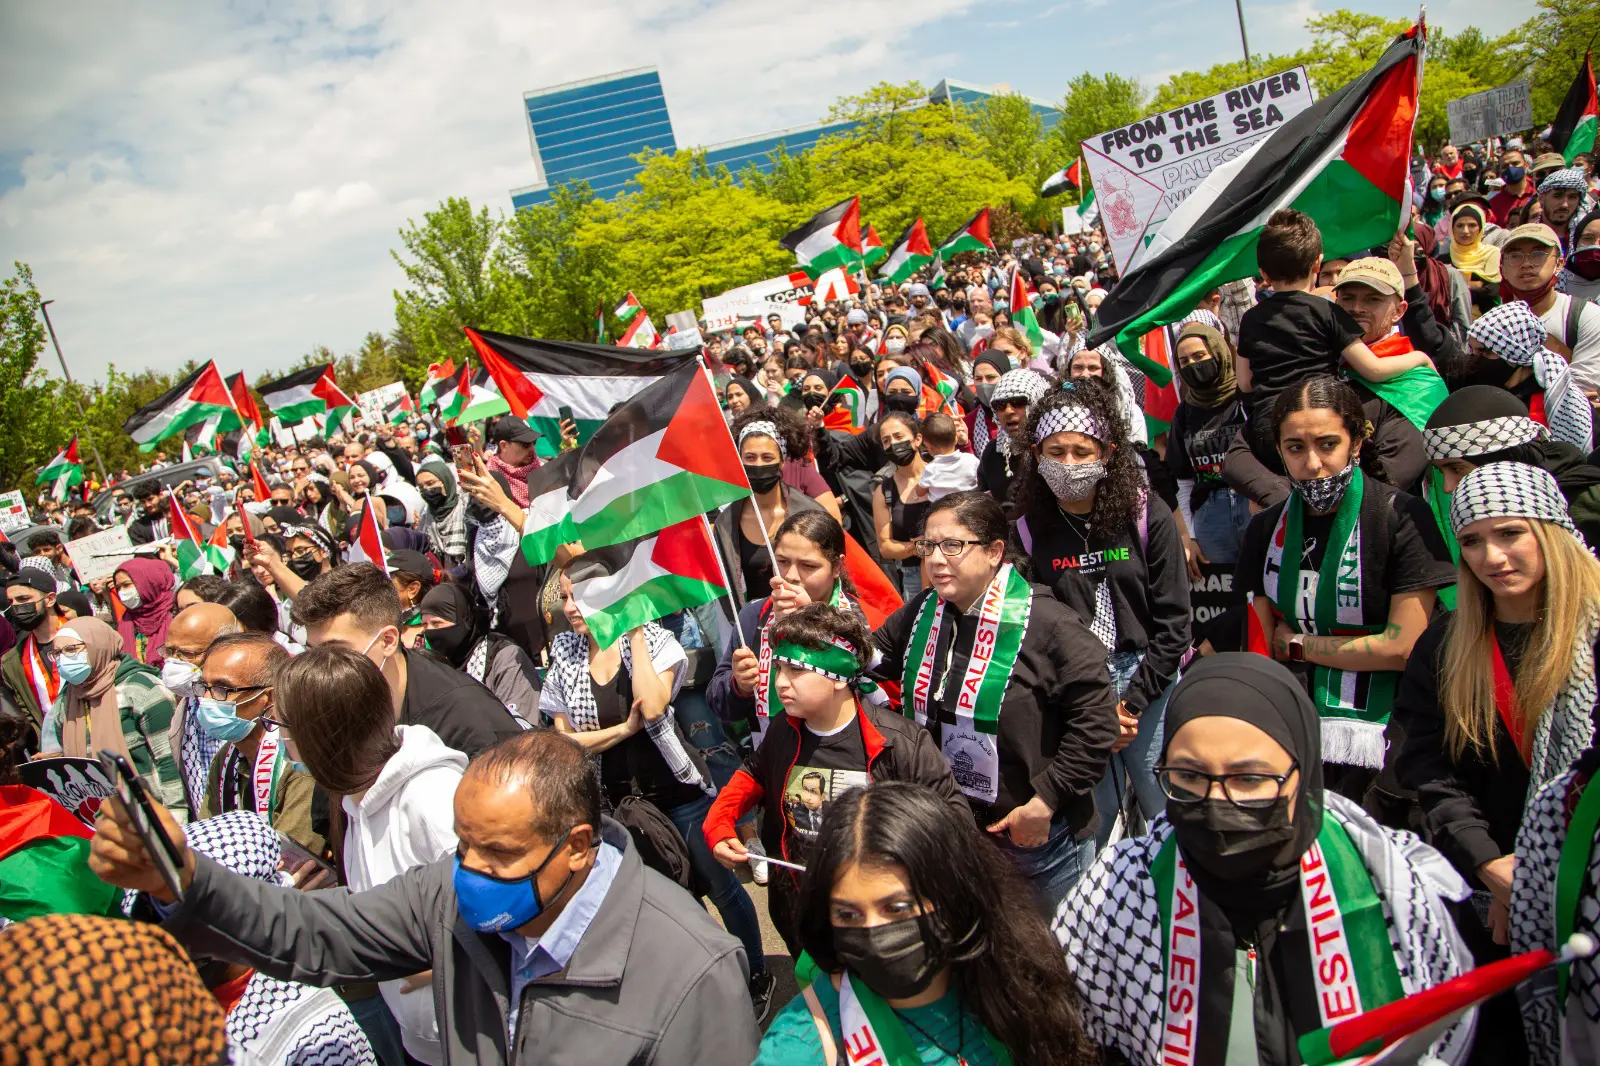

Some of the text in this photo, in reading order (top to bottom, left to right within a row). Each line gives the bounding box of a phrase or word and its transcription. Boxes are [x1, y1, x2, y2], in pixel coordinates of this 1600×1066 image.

[1101, 71, 1301, 154] FROM THE RIVER
[1500, 116, 1523, 133] YOU
[1129, 103, 1284, 169] TO THE SEA
[766, 286, 814, 304] LOCAL
[1195, 452, 1227, 466] TO TH
[1052, 547, 1130, 571] PALESTINE
[1190, 573, 1233, 592] RAE
[959, 577, 1003, 710] PALESTINE
